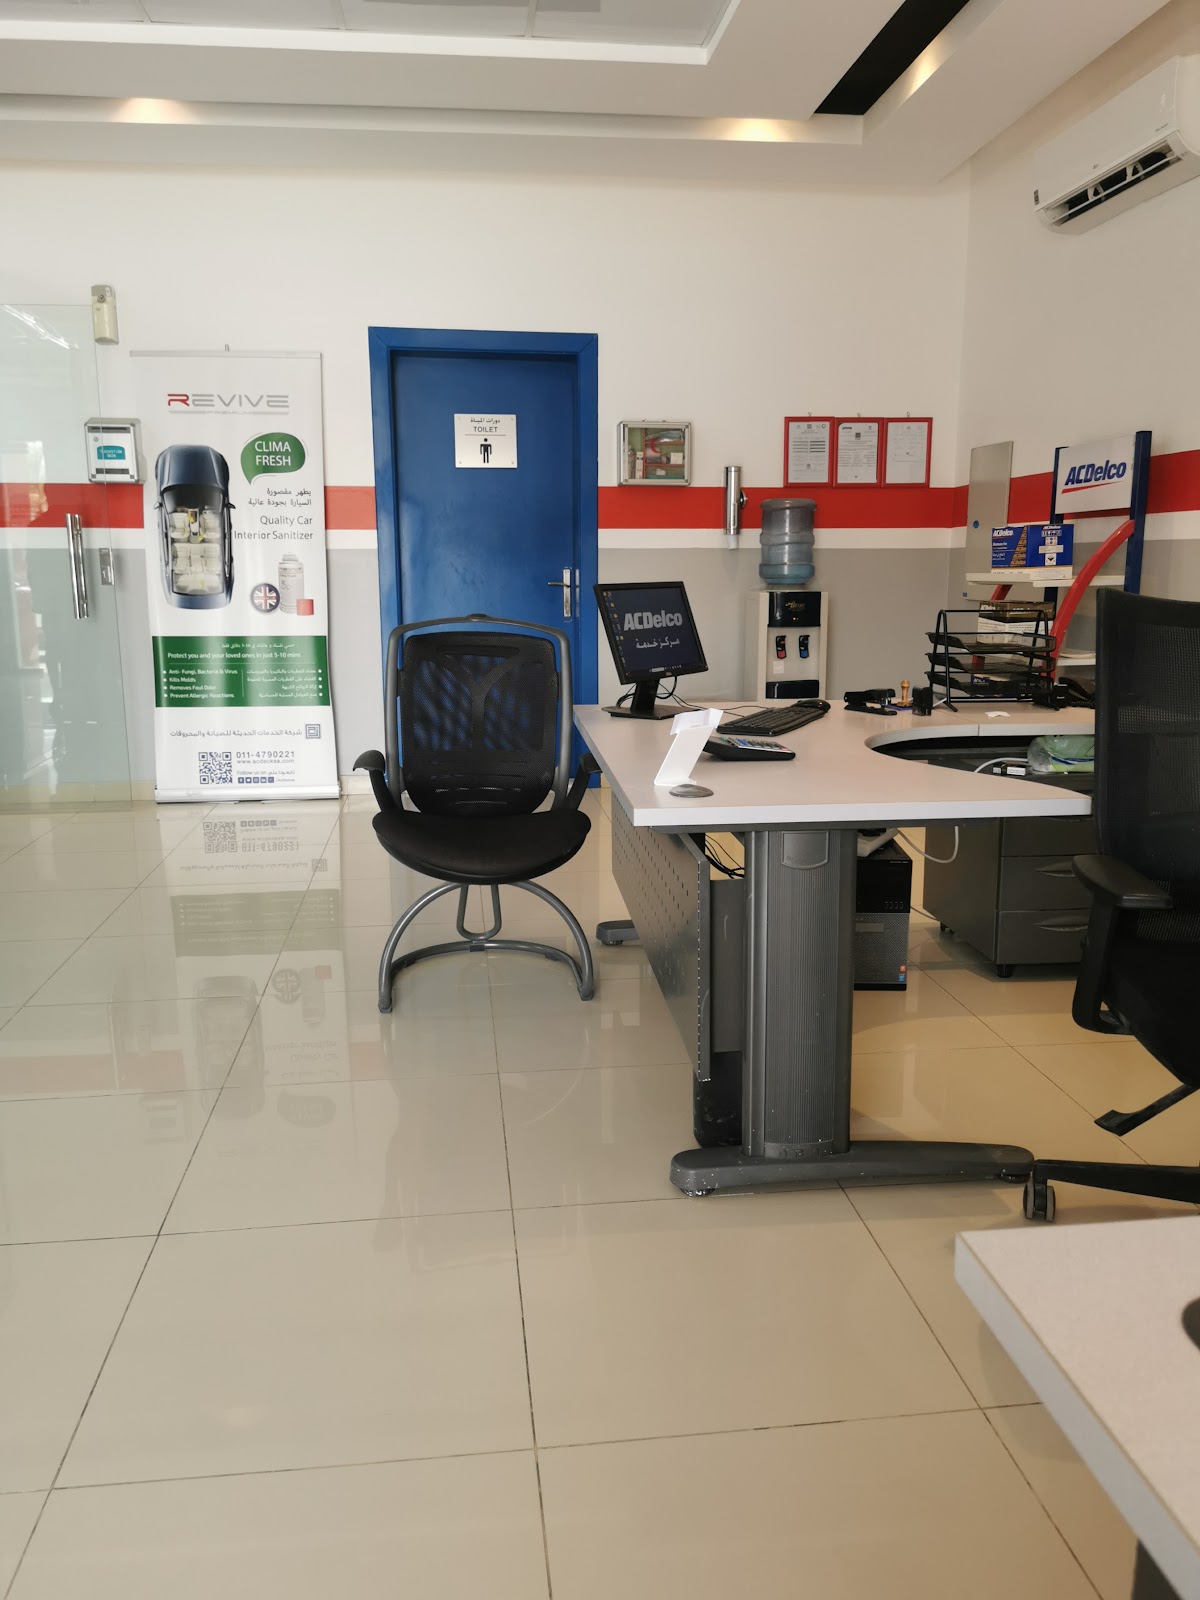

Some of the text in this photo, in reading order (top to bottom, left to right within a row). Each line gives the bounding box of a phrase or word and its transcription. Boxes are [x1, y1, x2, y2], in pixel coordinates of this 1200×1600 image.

[167, 393, 289, 408] REVIVE
[254, 440, 291, 452] CLIMA
[255, 454, 291, 466] FRESH
[1064, 460, 1127, 486] ACDelco
[266, 487, 312, 497] يطهر مقصورة
[248, 498, 312, 507] السيارة بجودة عالية
[260, 515, 313, 526] Quality Car
[234, 530, 313, 540] Interior Sanitizer
[623, 610, 683, 631] ACDelco
[635, 636, 680, 649] مركز خدمة
[169, 730, 205, 738] والمحروقات
[206, 730, 232, 738] للصيانة
[284, 729, 302, 737] شركة
